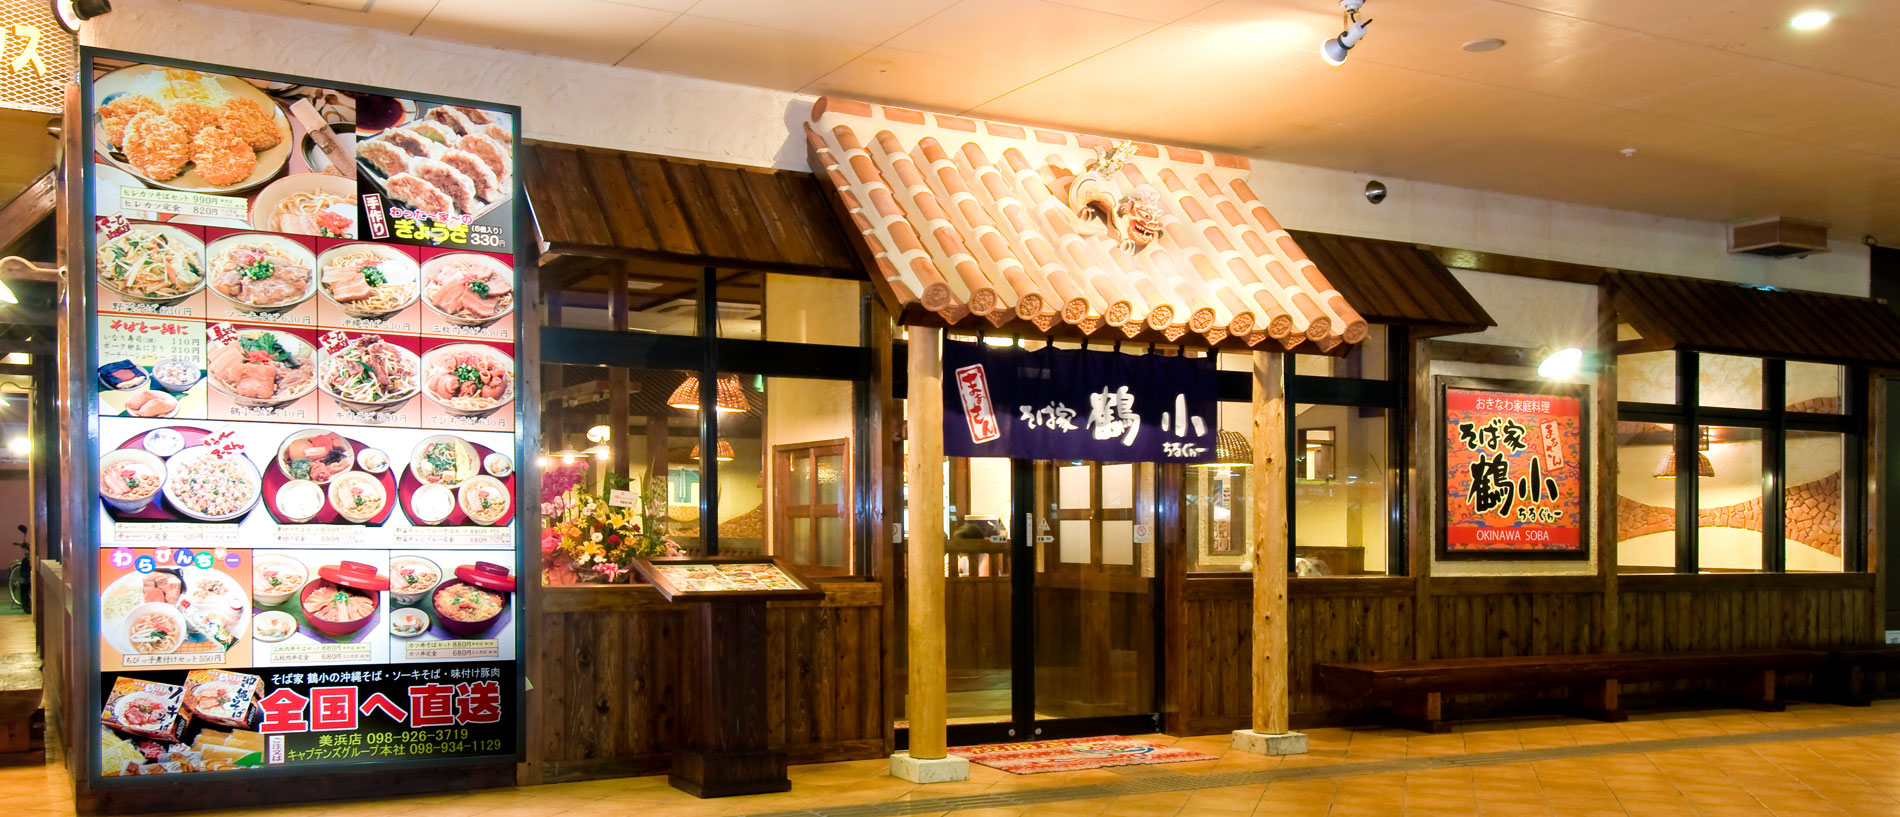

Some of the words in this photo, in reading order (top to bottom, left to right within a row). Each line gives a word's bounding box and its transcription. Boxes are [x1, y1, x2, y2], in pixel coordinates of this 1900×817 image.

[123, 189, 189, 202] ヒレカツそばセット
[193, 196, 218, 206] 990円
[124, 200, 182, 213] ヒレカツ定食
[193, 206, 218, 216] 820円
[366, 196, 385, 236] 手作り
[393, 218, 469, 244] ぎょうざ
[470, 233, 506, 247] 330円
[109, 319, 189, 336] そばと一緒に
[171, 337, 200, 347] 110円
[171, 346, 200, 355] 210円
[1475, 396, 1551, 414] おきなわ家庭料理
[1019, 401, 1079, 434] そば家
[1086, 385, 1208, 447] 鶴小
[1459, 418, 1527, 452] そば家
[1466, 453, 1559, 517] 鶴小
[1476, 530, 1521, 541] OKINAWA
[1525, 530, 1550, 541] SOBA
[271, 672, 304, 684] そば家
[257, 680, 502, 734] 全国へ直送
[318, 733, 362, 748] 美浜店
[366, 729, 469, 745] 098-926-3719
[287, 743, 406, 761] キャプテンズグループ本社
[409, 739, 502, 755] 098-934-1129
